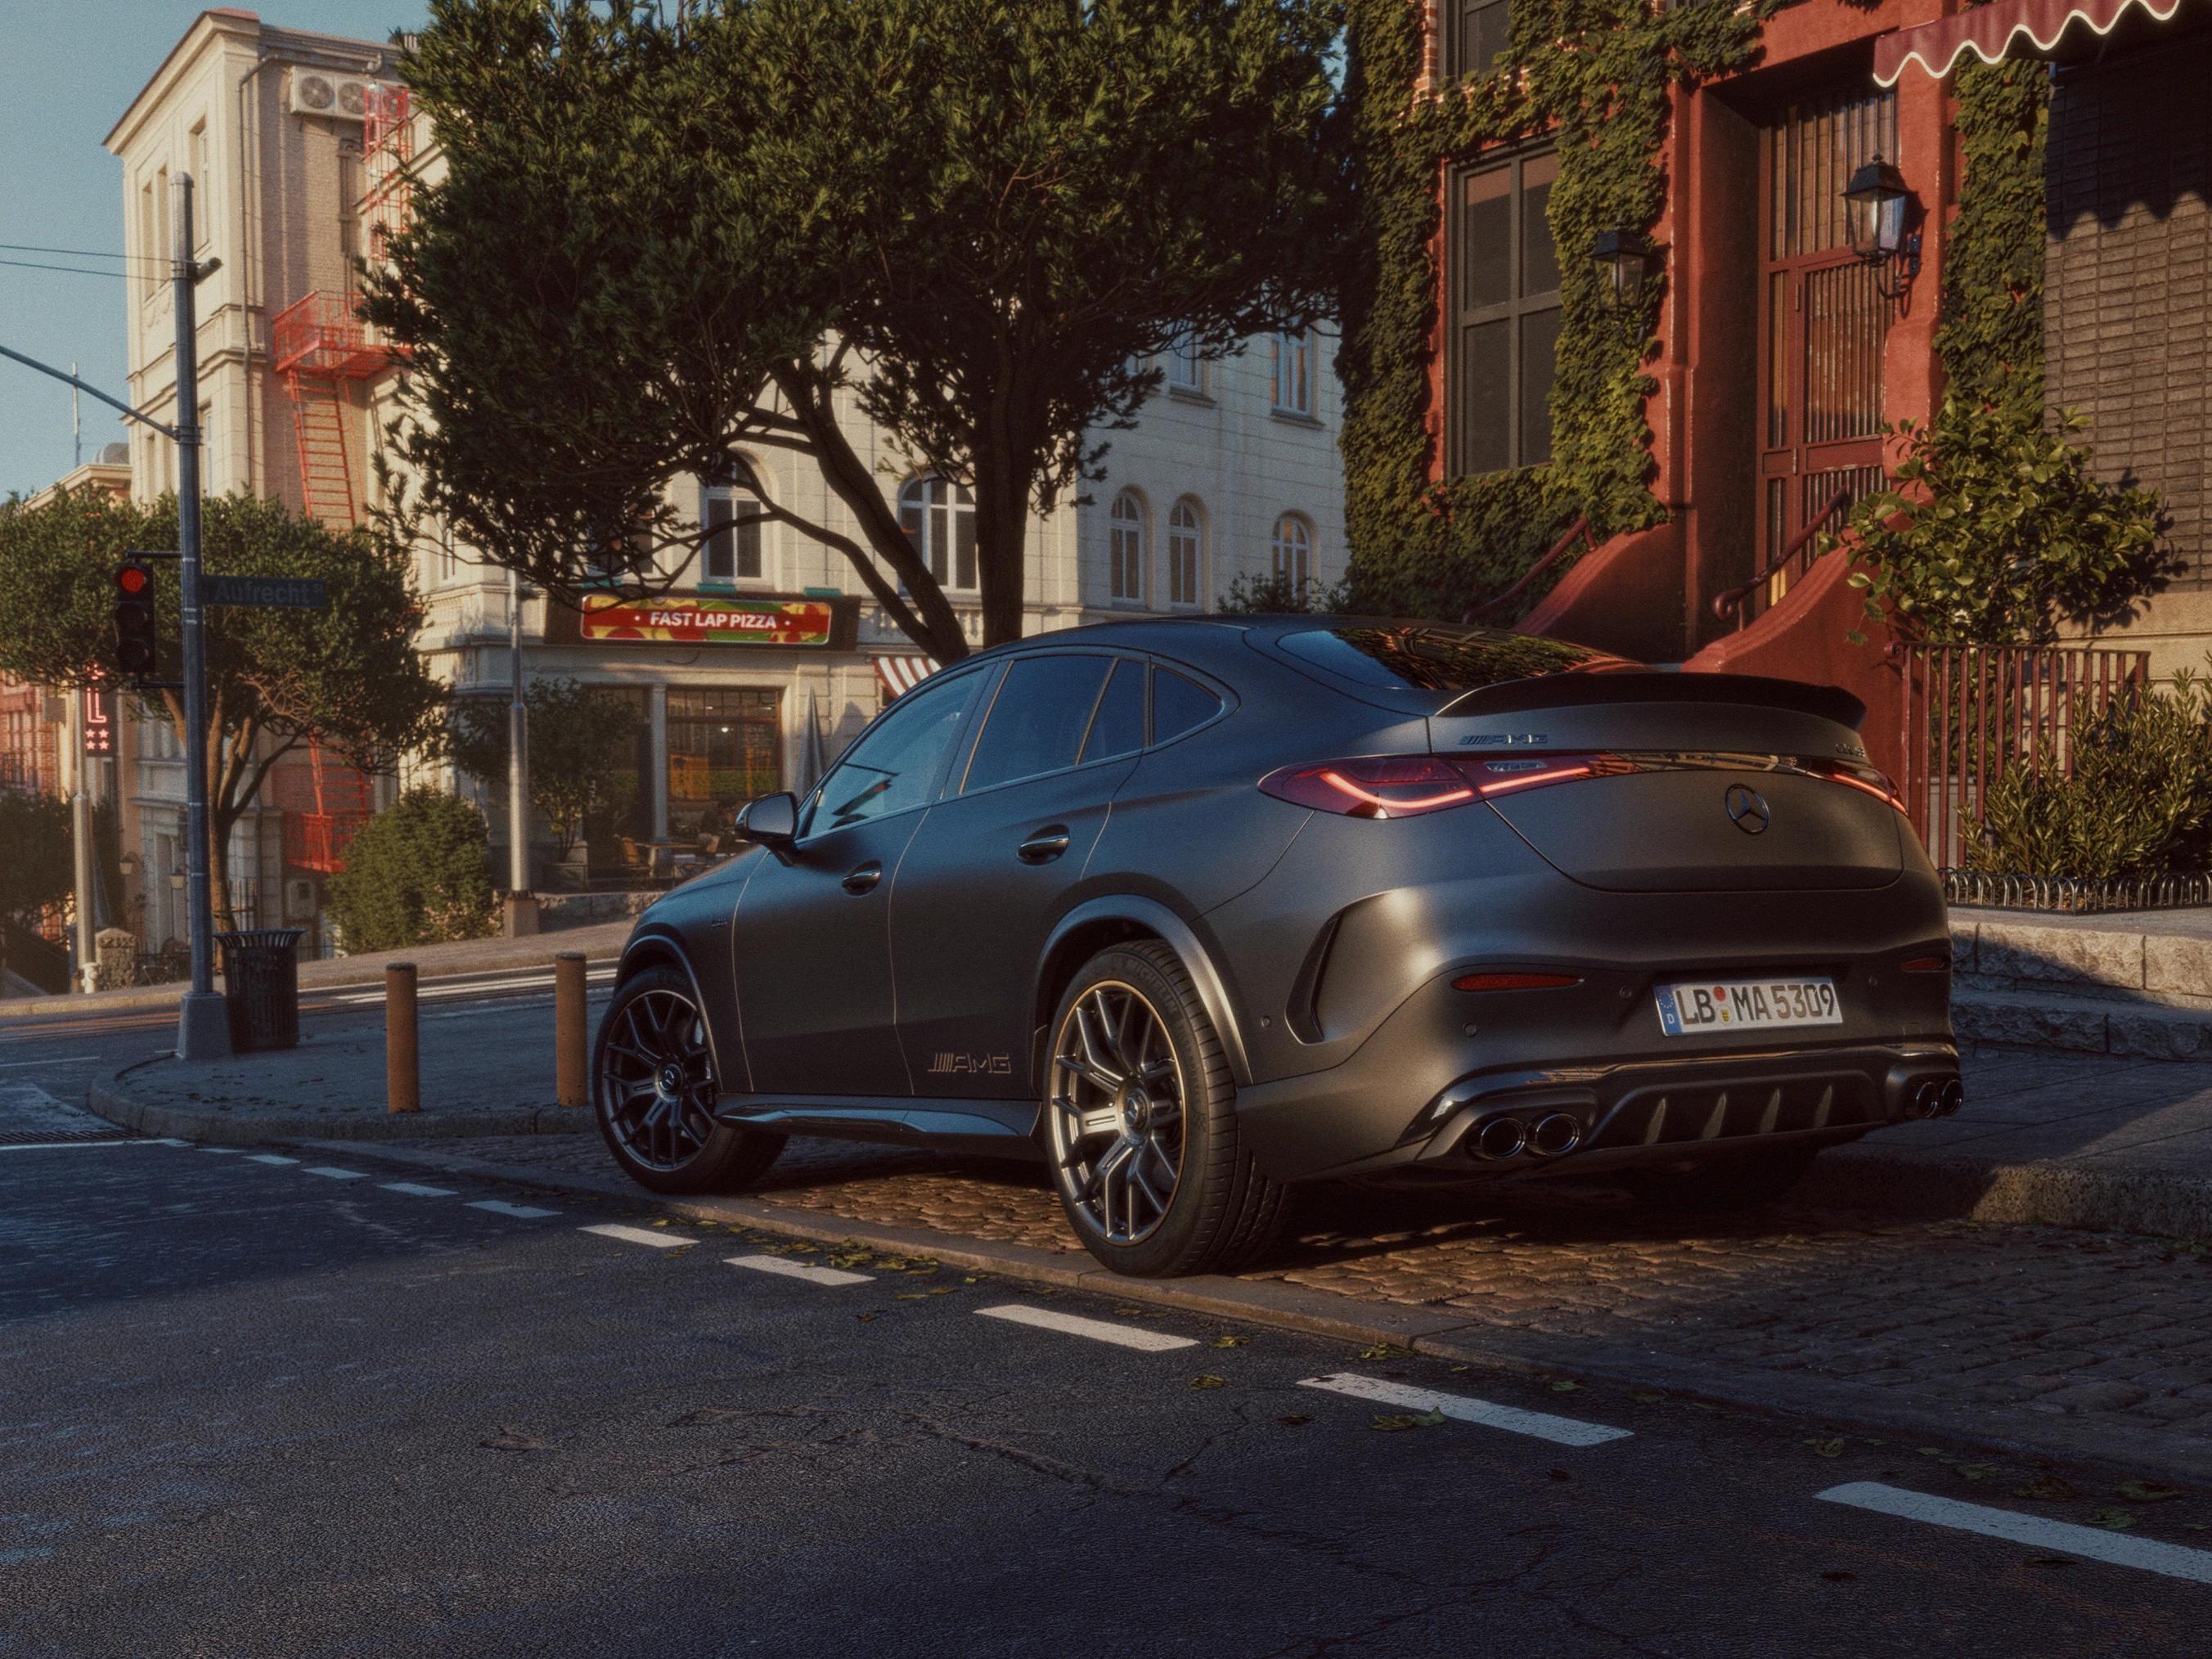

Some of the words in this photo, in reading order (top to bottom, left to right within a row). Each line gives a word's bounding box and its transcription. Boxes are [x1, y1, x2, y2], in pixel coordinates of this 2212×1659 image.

[214, 579, 311, 604] Aufrecht
[650, 611, 693, 627] FAST
[695, 613, 727, 627] LAP
[730, 614, 776, 629] PIZZA
[1675, 989, 1715, 1025] LB
[1731, 986, 1771, 1022] MA
[1770, 984, 1835, 1018] 5309
[1666, 1014, 1675, 1024] D
